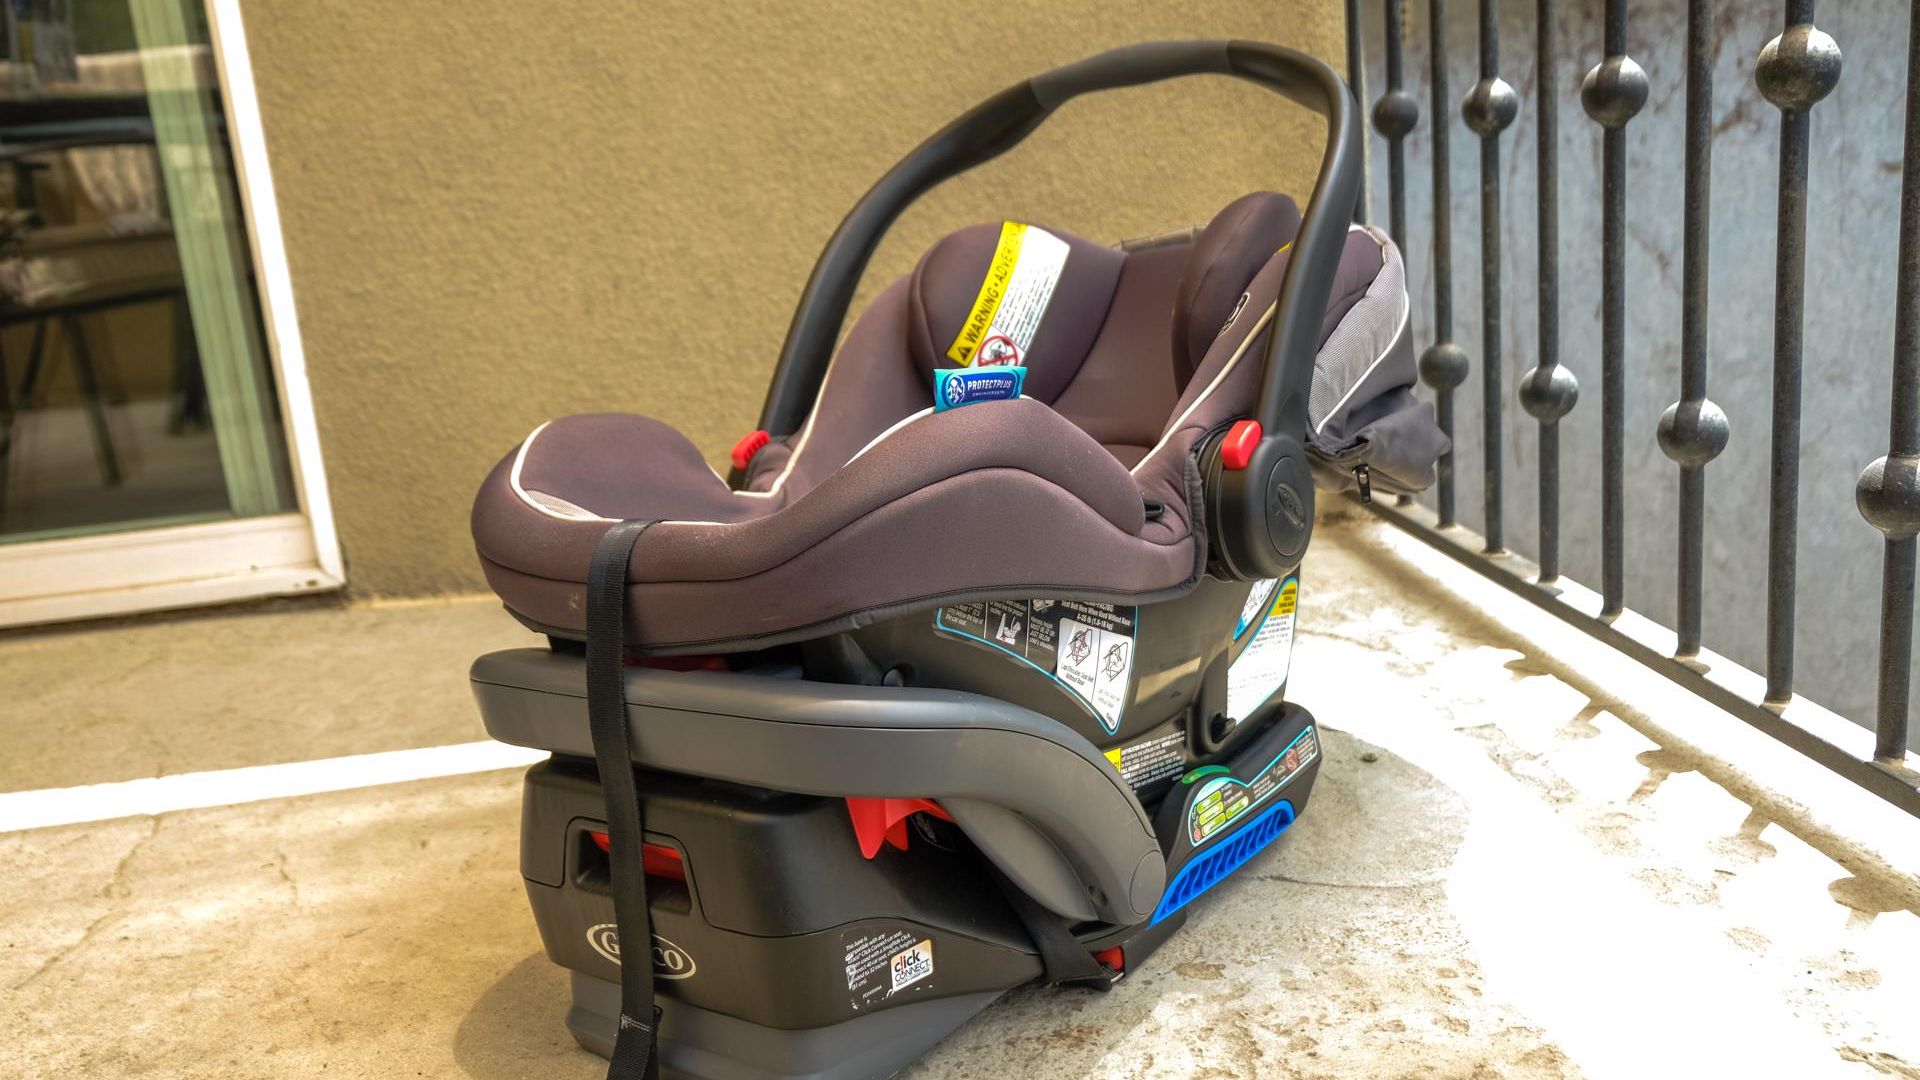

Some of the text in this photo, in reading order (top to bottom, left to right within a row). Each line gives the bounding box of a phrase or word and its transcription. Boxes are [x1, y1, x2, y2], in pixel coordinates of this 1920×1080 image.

[964, 287, 999, 344] WARNING
[601, 931, 683, 970] GCO
[894, 949, 920, 973] click
[895, 958, 929, 982] CONNECT
